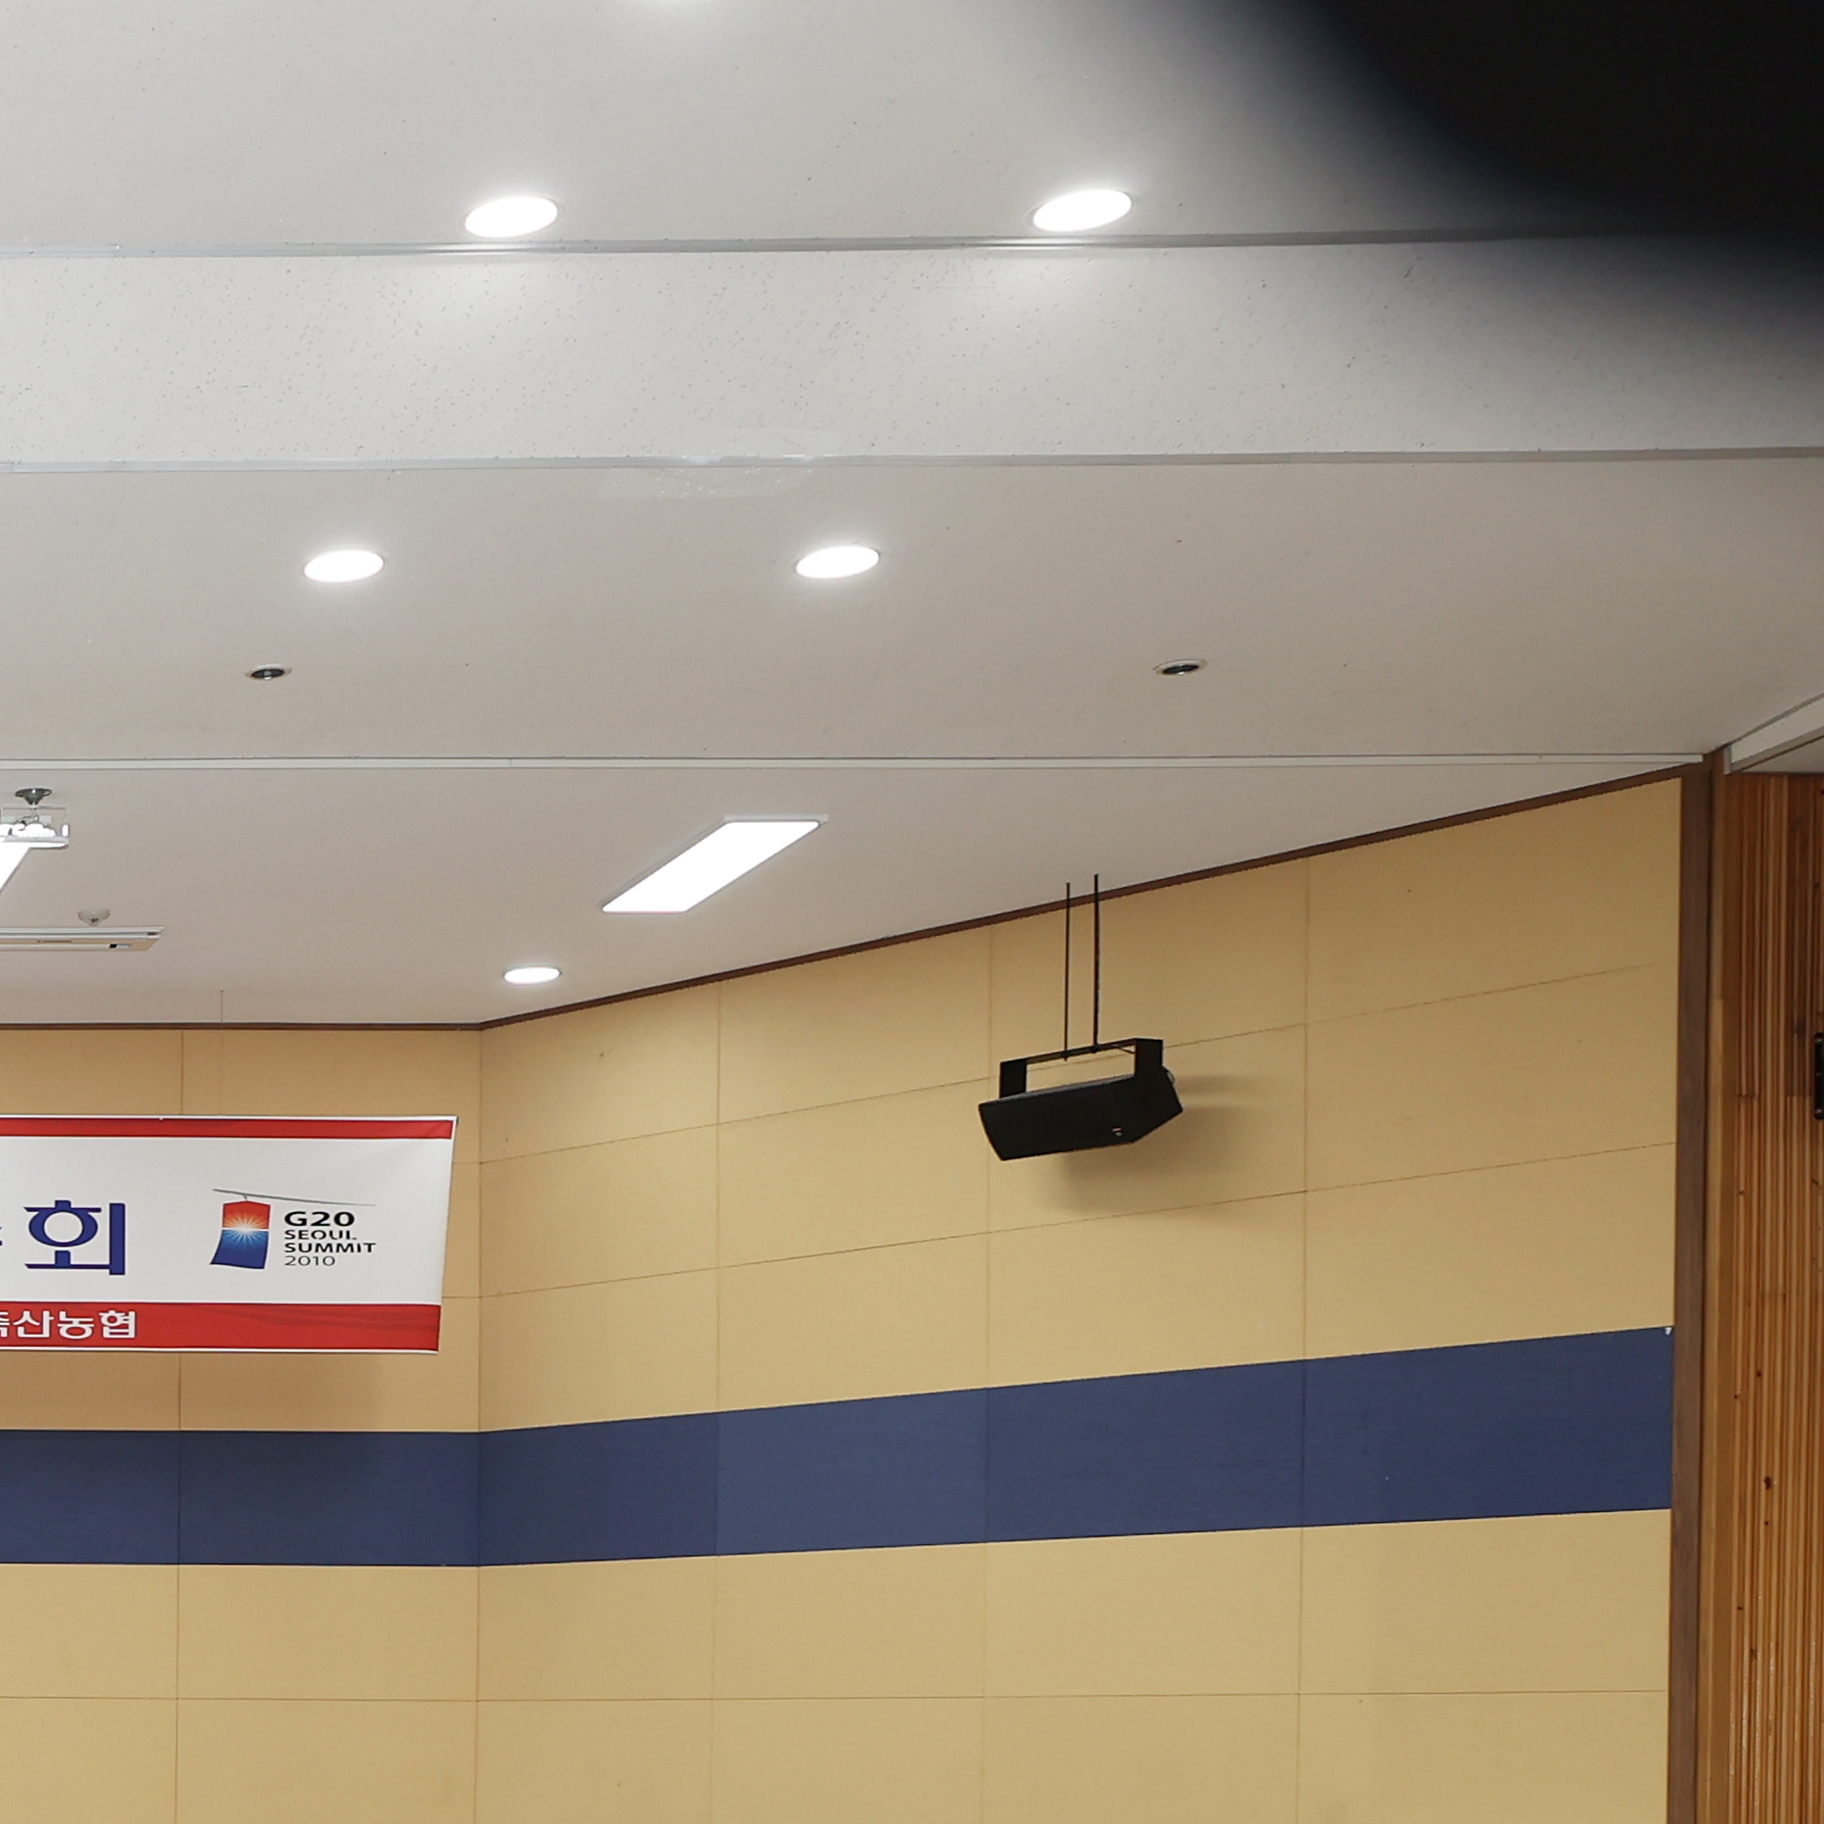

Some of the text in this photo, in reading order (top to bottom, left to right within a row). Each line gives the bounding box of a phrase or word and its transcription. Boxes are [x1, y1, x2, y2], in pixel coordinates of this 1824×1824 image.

[283, 1210, 356, 1228] G20
[283, 1229, 358, 1241] SEOUL
[283, 1242, 377, 1254] SUMMIT
[283, 1255, 336, 1267] 2010
